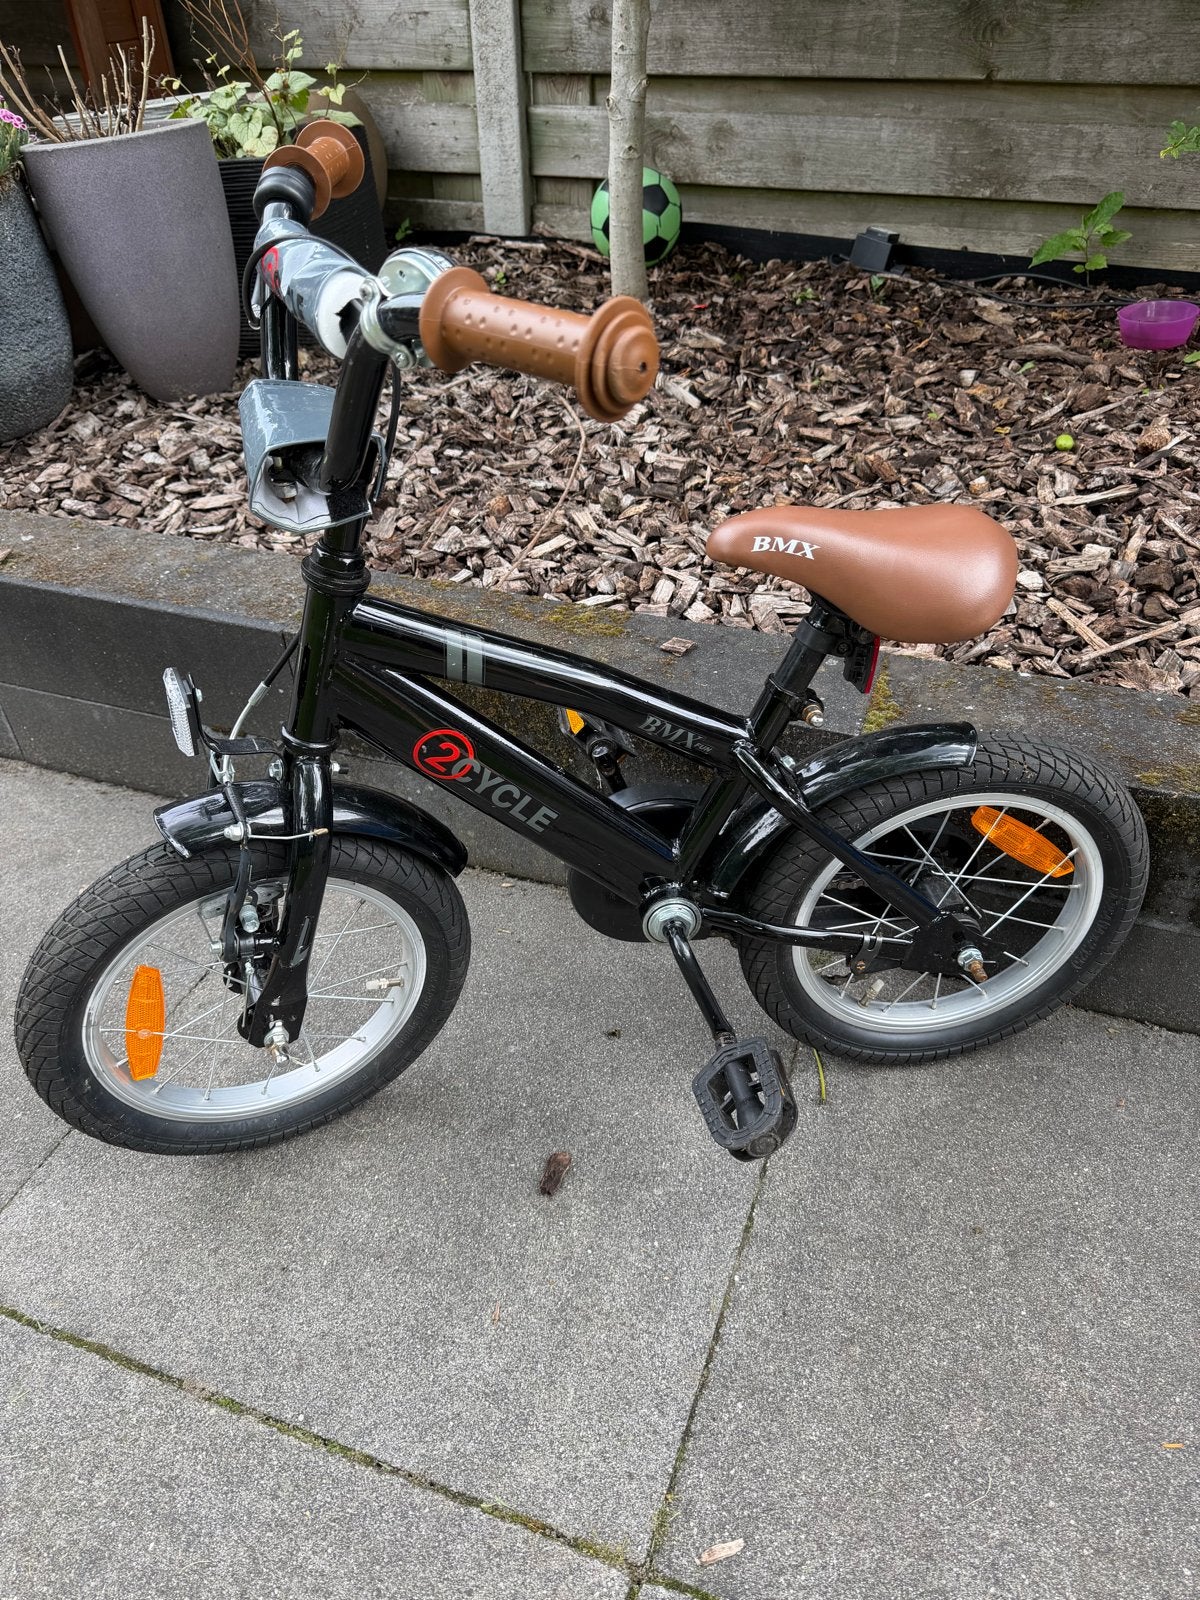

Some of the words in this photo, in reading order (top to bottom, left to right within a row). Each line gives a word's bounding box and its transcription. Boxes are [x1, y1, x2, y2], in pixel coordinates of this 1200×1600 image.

[751, 536, 820, 560] BMX
[639, 715, 704, 749] BMX
[693, 742, 713, 755] FUN
